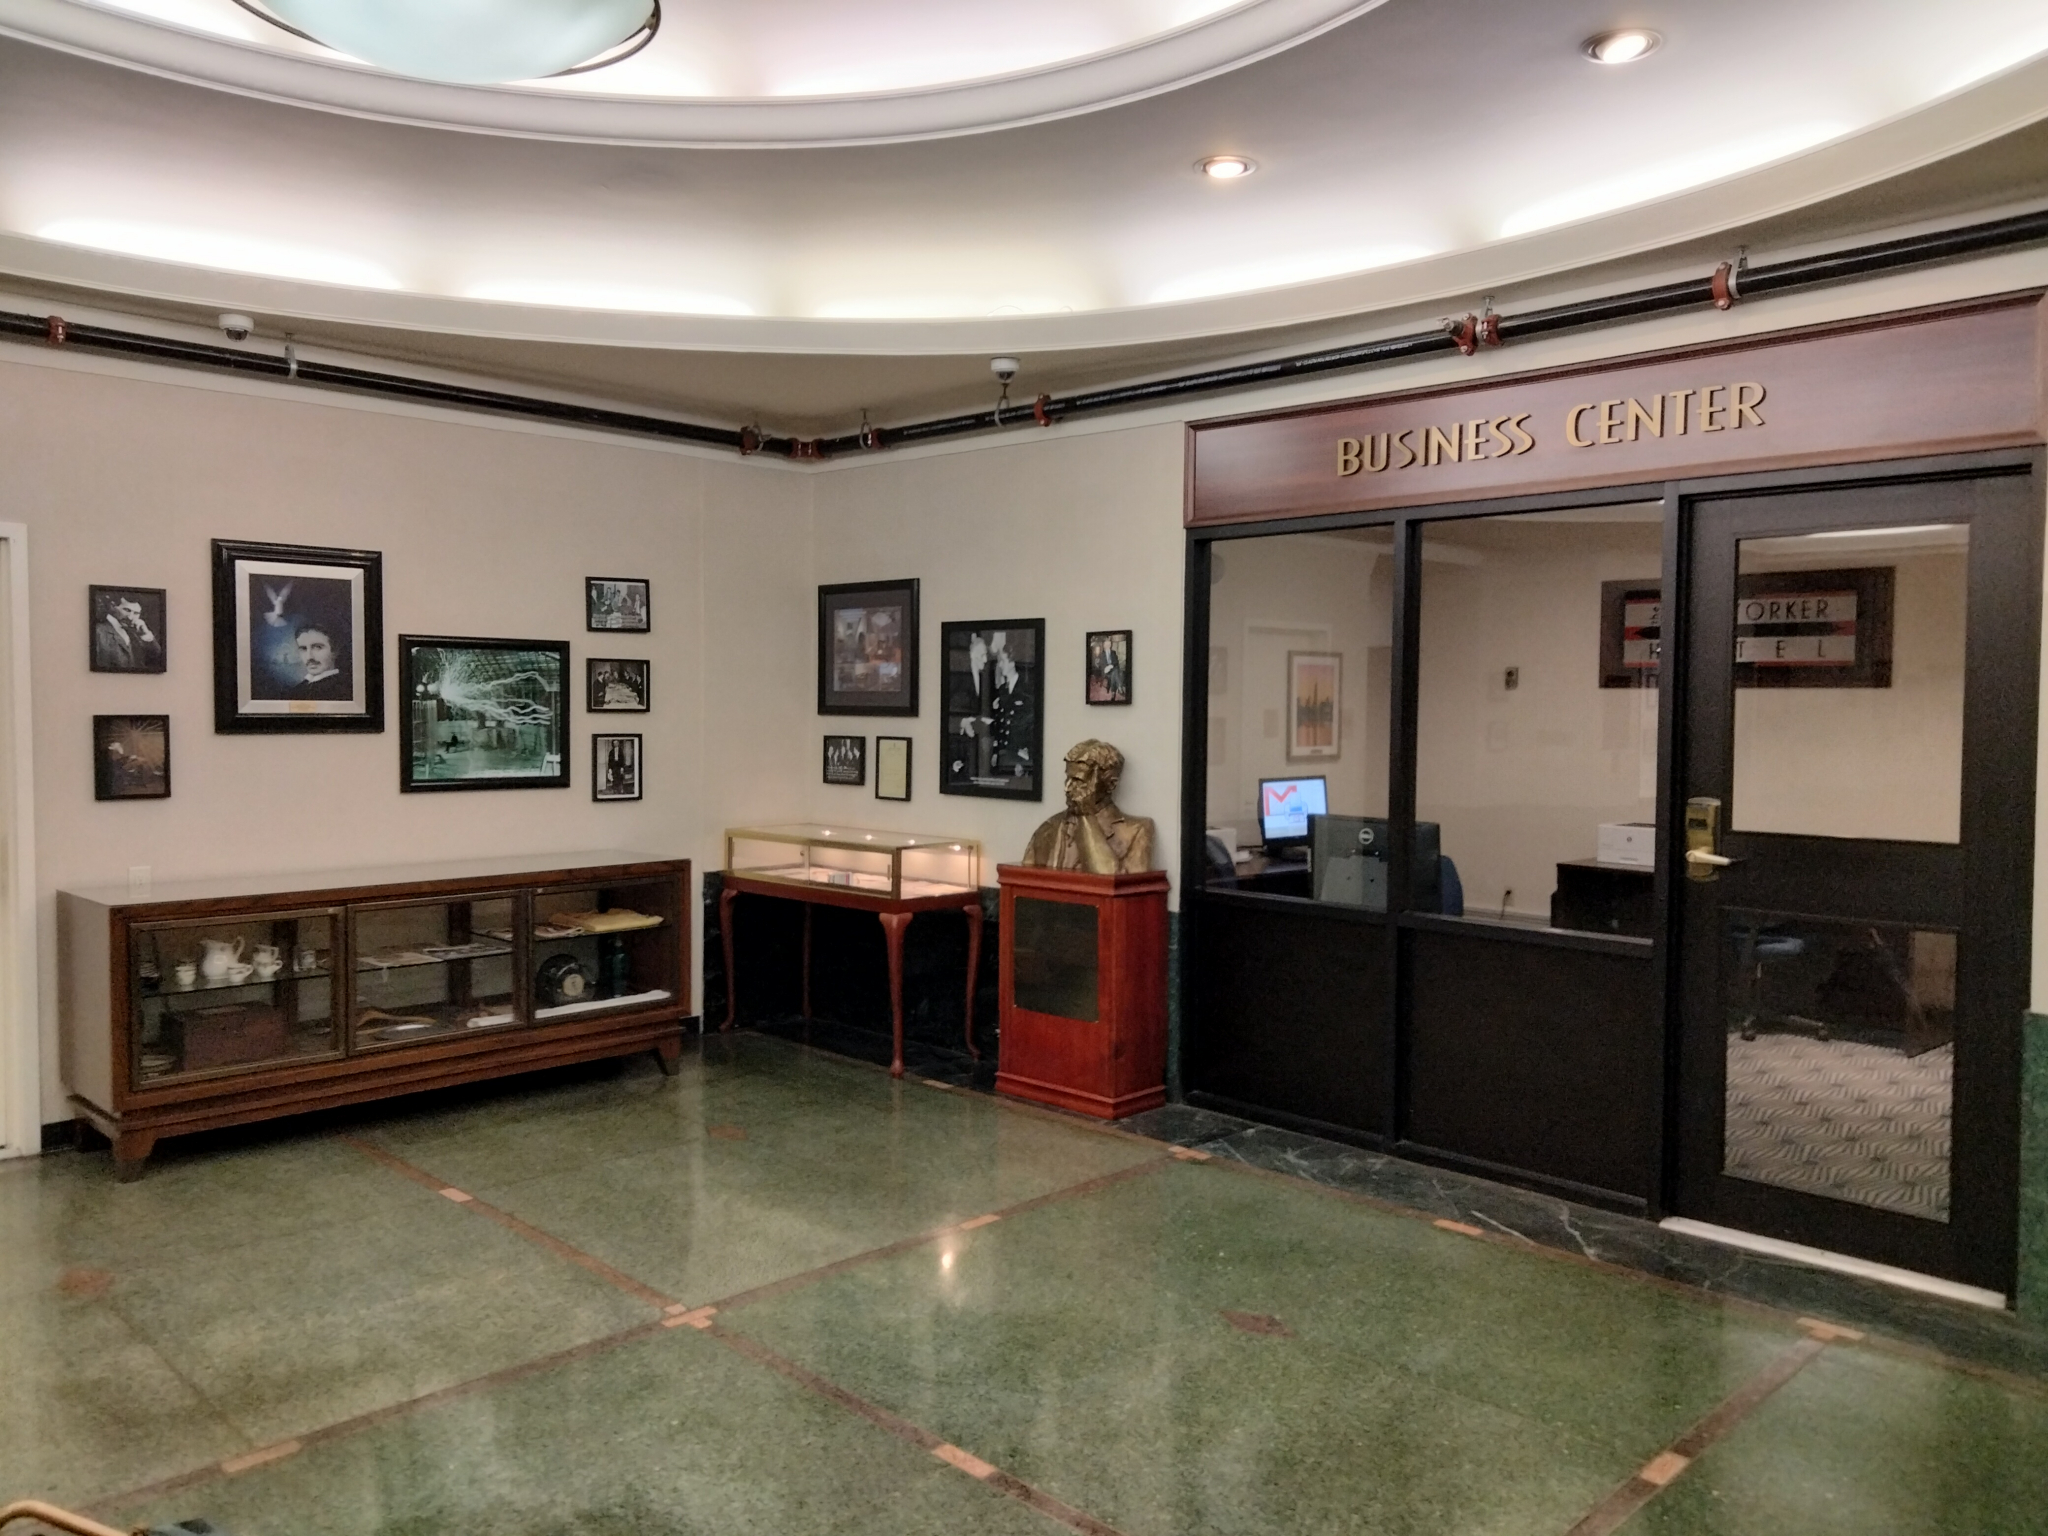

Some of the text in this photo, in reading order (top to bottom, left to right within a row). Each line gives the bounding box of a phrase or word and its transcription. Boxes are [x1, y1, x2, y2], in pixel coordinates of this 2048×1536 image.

[1336, 381, 1767, 478] BUSINESS CENTER
[1738, 598, 1830, 621] ORKER
